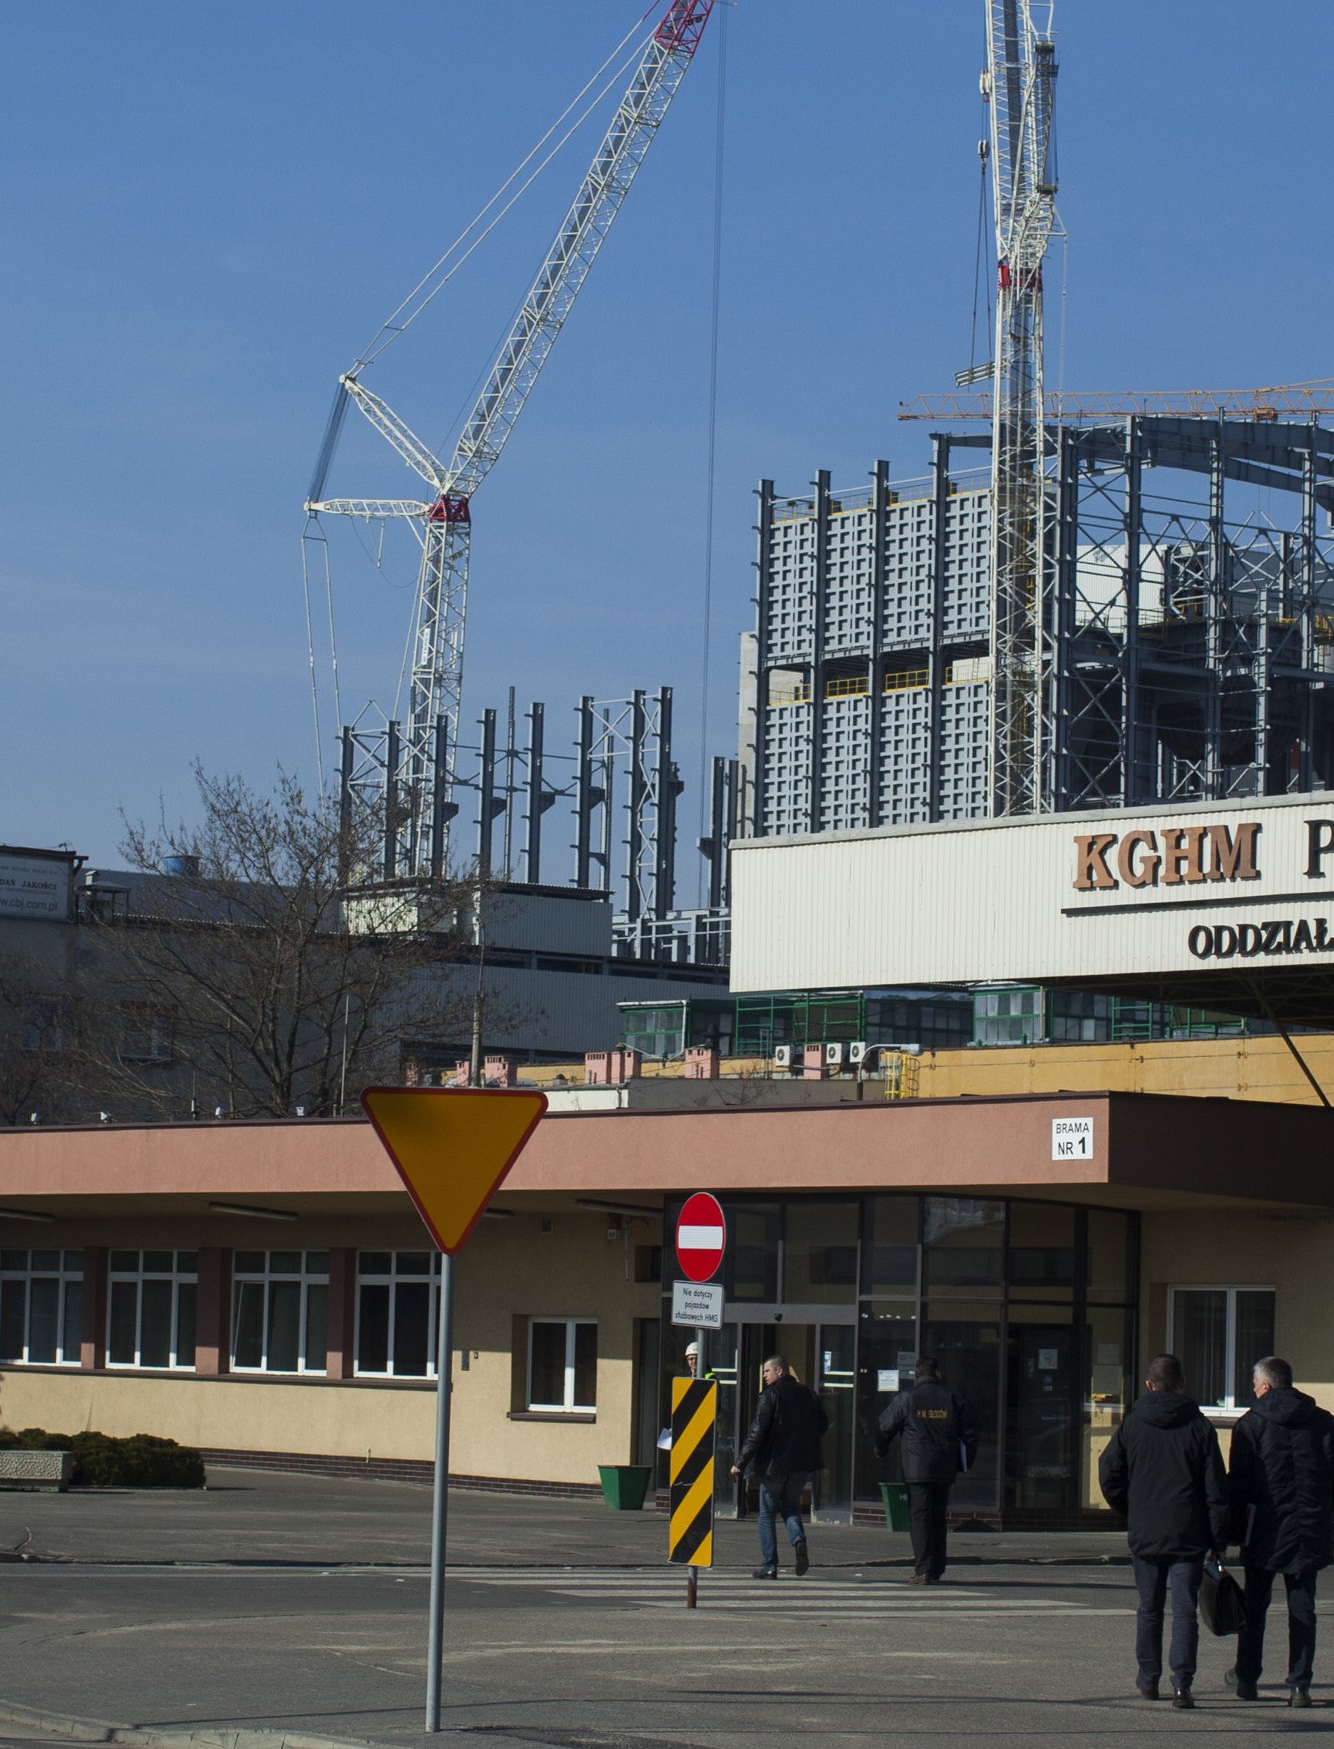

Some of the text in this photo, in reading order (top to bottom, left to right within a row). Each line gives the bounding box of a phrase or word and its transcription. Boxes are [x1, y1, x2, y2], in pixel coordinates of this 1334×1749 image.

[1072, 822, 1263, 891] KGHM
[21, 880, 57, 891] JAKOŚCI
[1056, 1123, 1089, 1134] BRAMA
[1058, 1136, 1086, 1155] NR 1
[683, 1288, 713, 1300] Nie dotyczy
[705, 1314, 718, 1322] HMG
